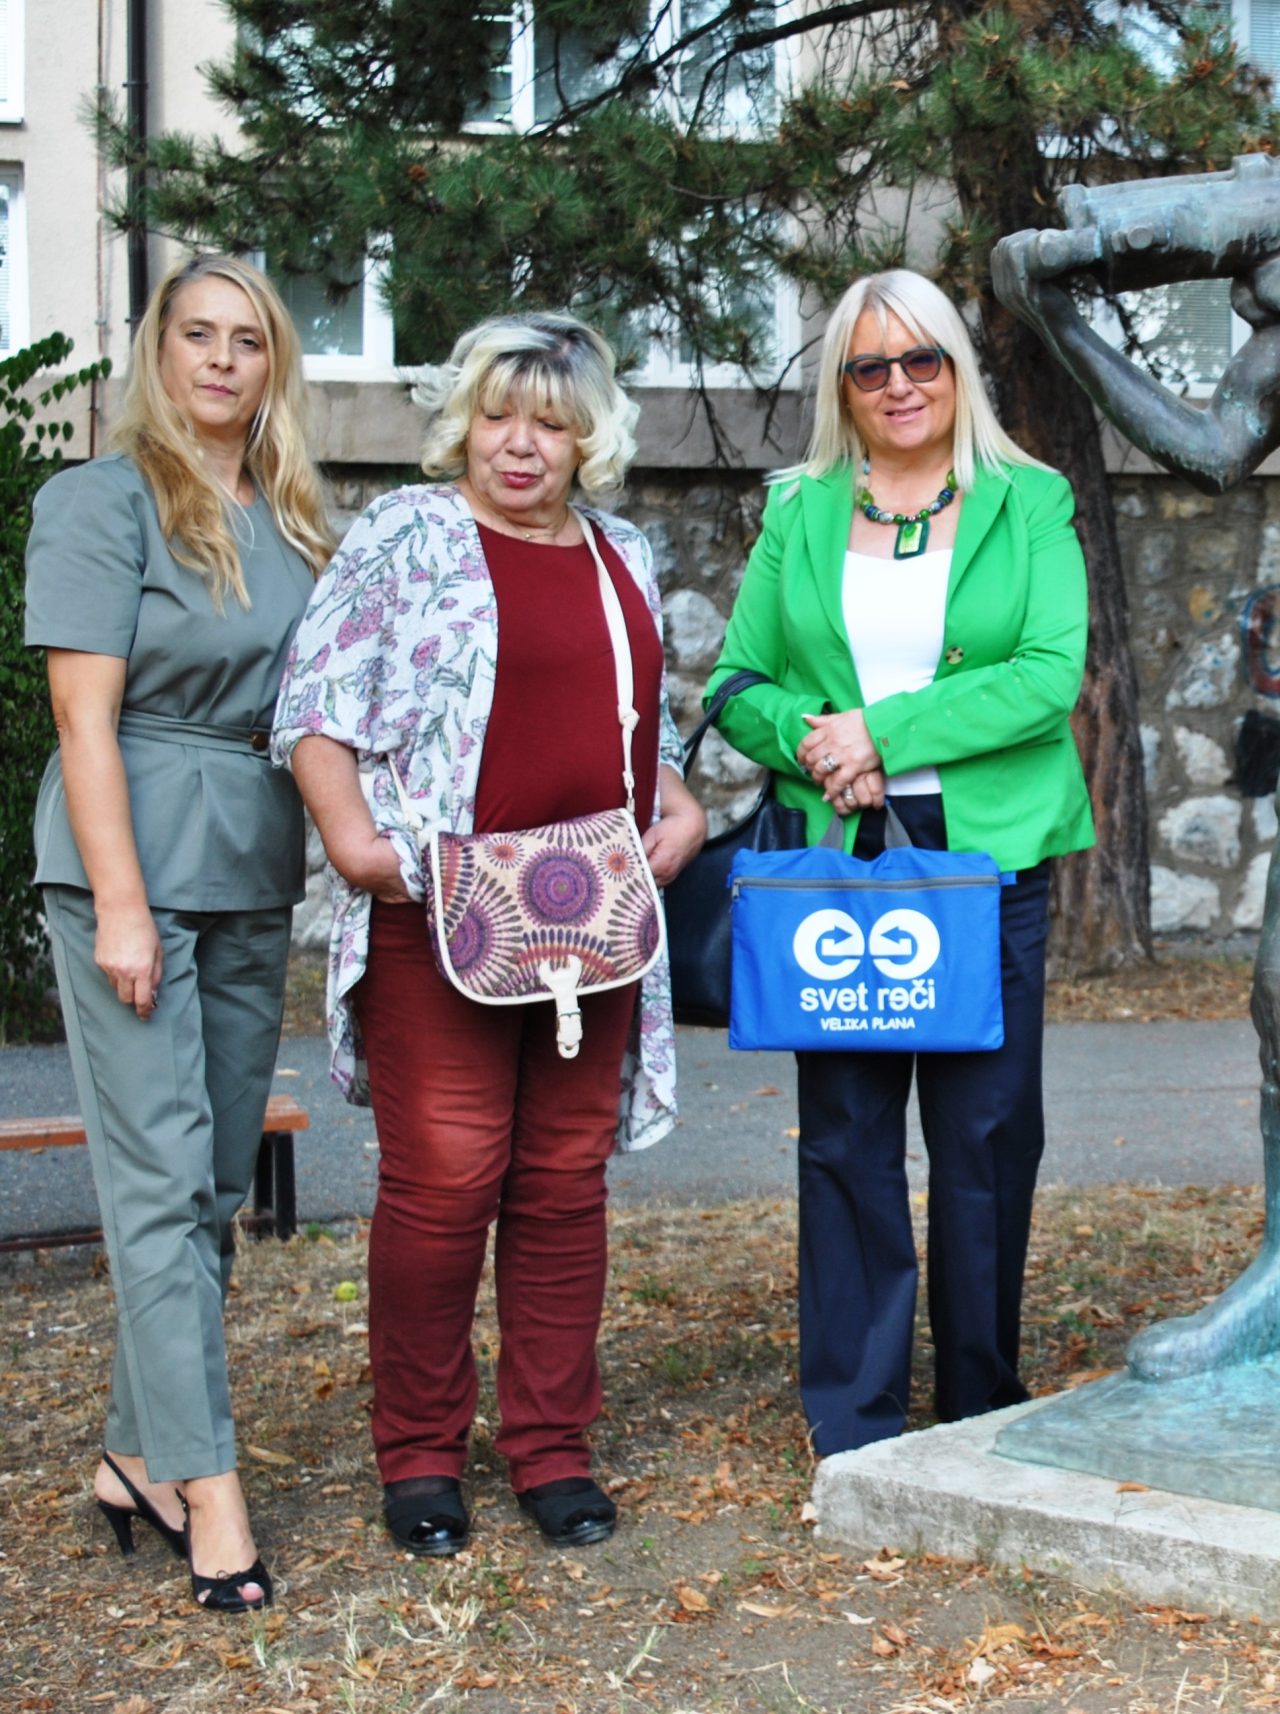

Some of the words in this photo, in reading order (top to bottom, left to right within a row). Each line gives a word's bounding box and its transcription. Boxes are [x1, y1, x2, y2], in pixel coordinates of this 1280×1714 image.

[800, 981, 869, 1012] svet
[820, 1017, 869, 1031] VELIKA
[872, 1016, 916, 1030] PLANA
